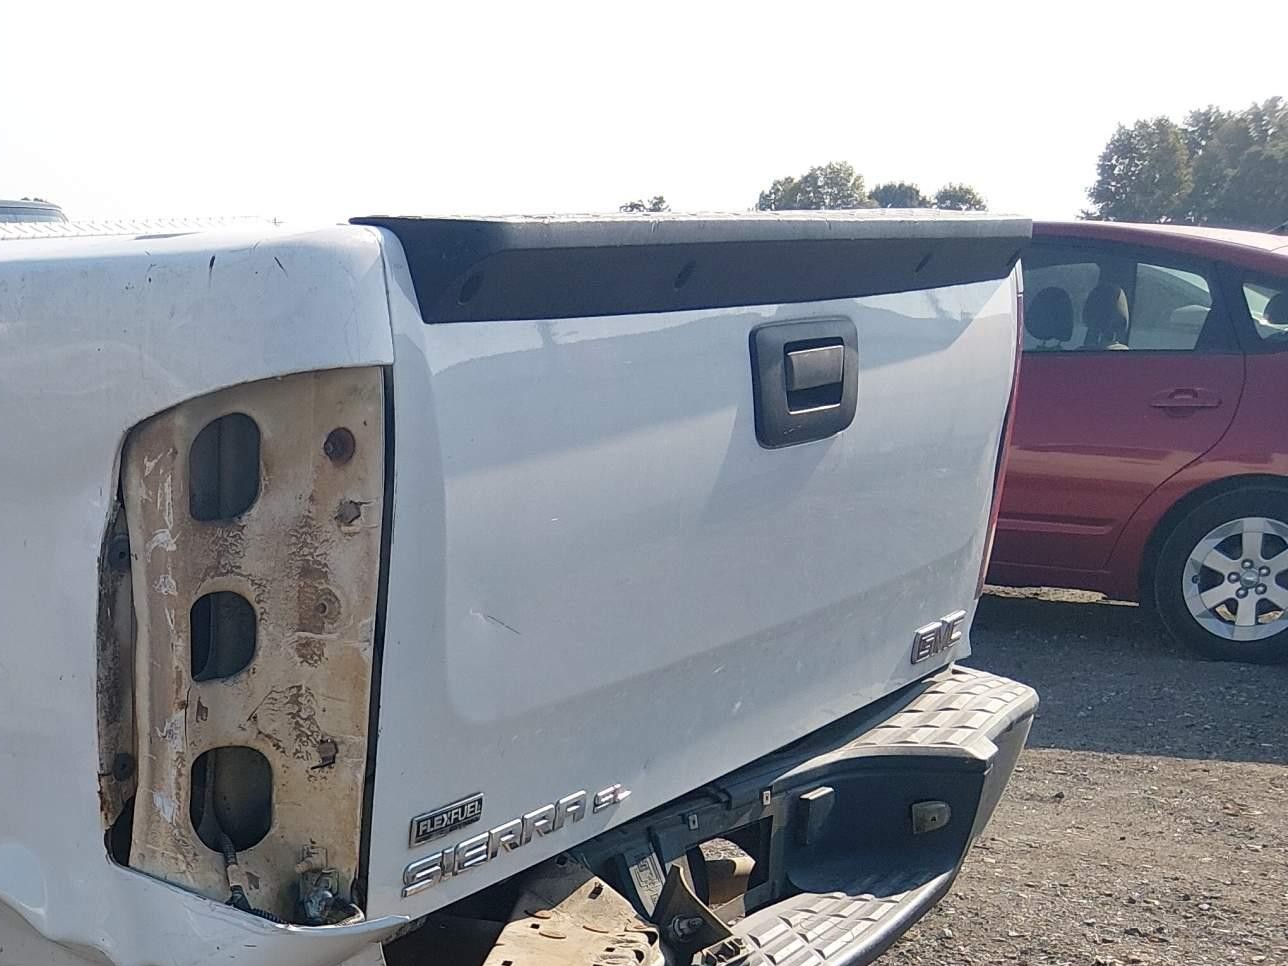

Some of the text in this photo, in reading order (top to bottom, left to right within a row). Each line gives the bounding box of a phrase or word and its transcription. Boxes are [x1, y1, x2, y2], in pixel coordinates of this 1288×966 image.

[911, 609, 966, 664] GMC
[402, 789, 587, 898] SIERRA
[417, 800, 481, 836] FLEXFUEL
